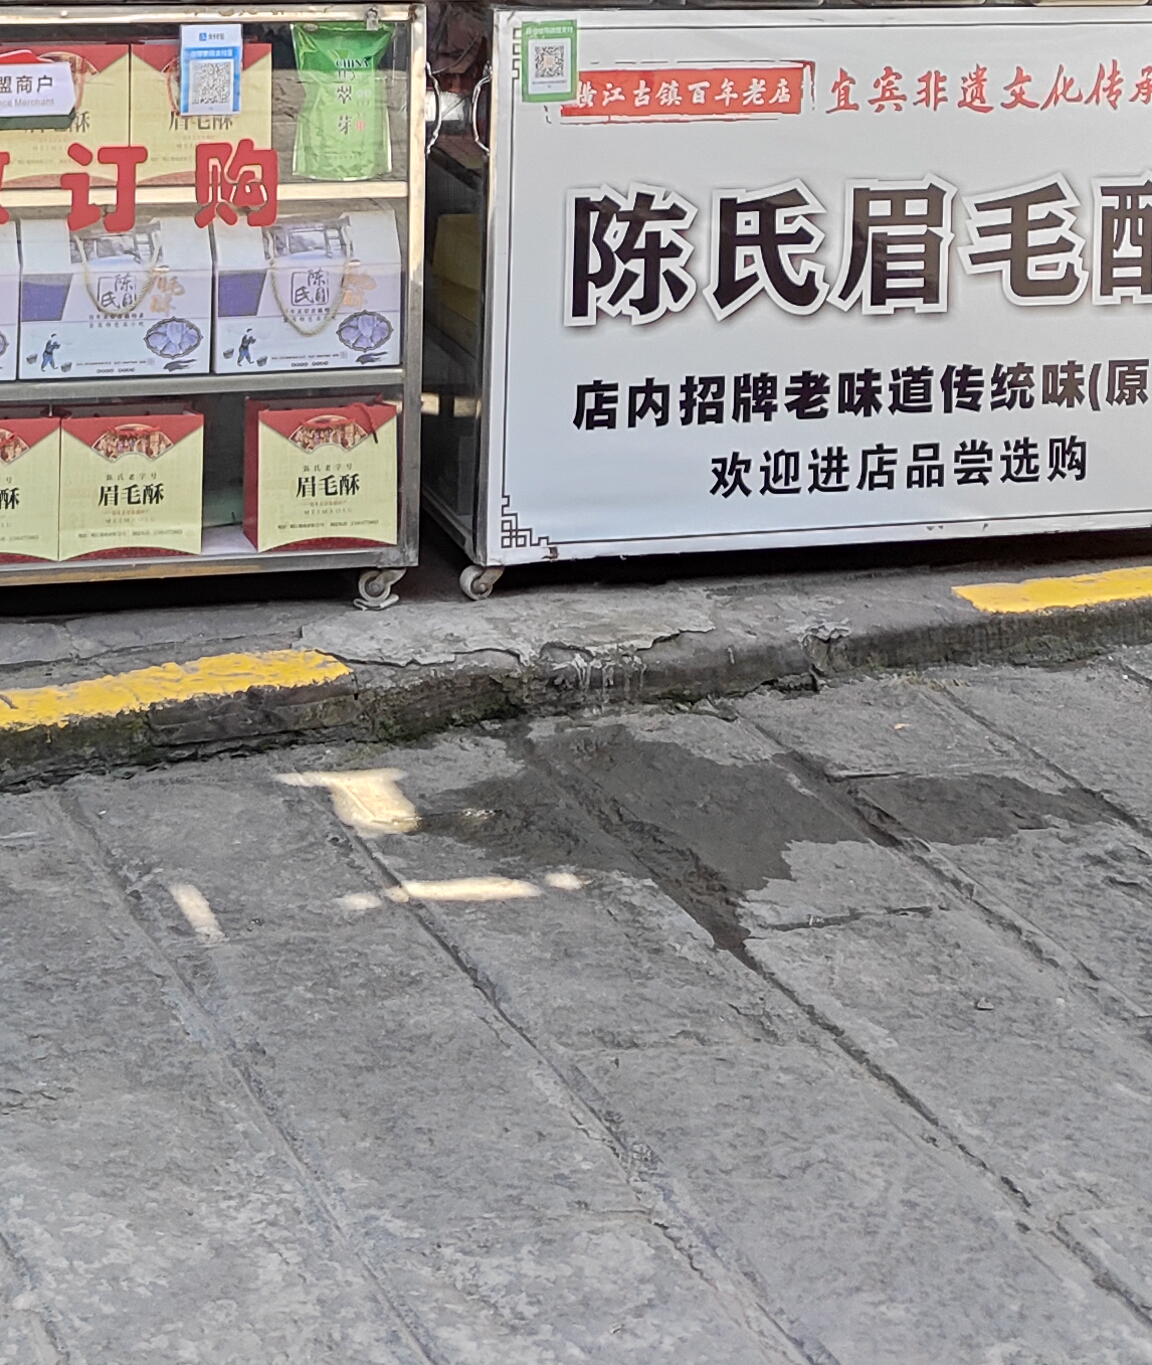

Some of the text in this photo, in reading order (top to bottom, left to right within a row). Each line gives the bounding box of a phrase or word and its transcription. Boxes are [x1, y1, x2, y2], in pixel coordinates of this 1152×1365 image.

[14, 97, 55, 108] Merchant
[576, 77, 792, 108] 横江古镇百年老店
[573, 358, 1150, 430] 店内招牌老味道传统味(原
[710, 435, 1088, 499] 欢迎进店品尝选购
[98, 482, 165, 506] 眉毛酥
[295, 473, 361, 498] 眉毛酥
